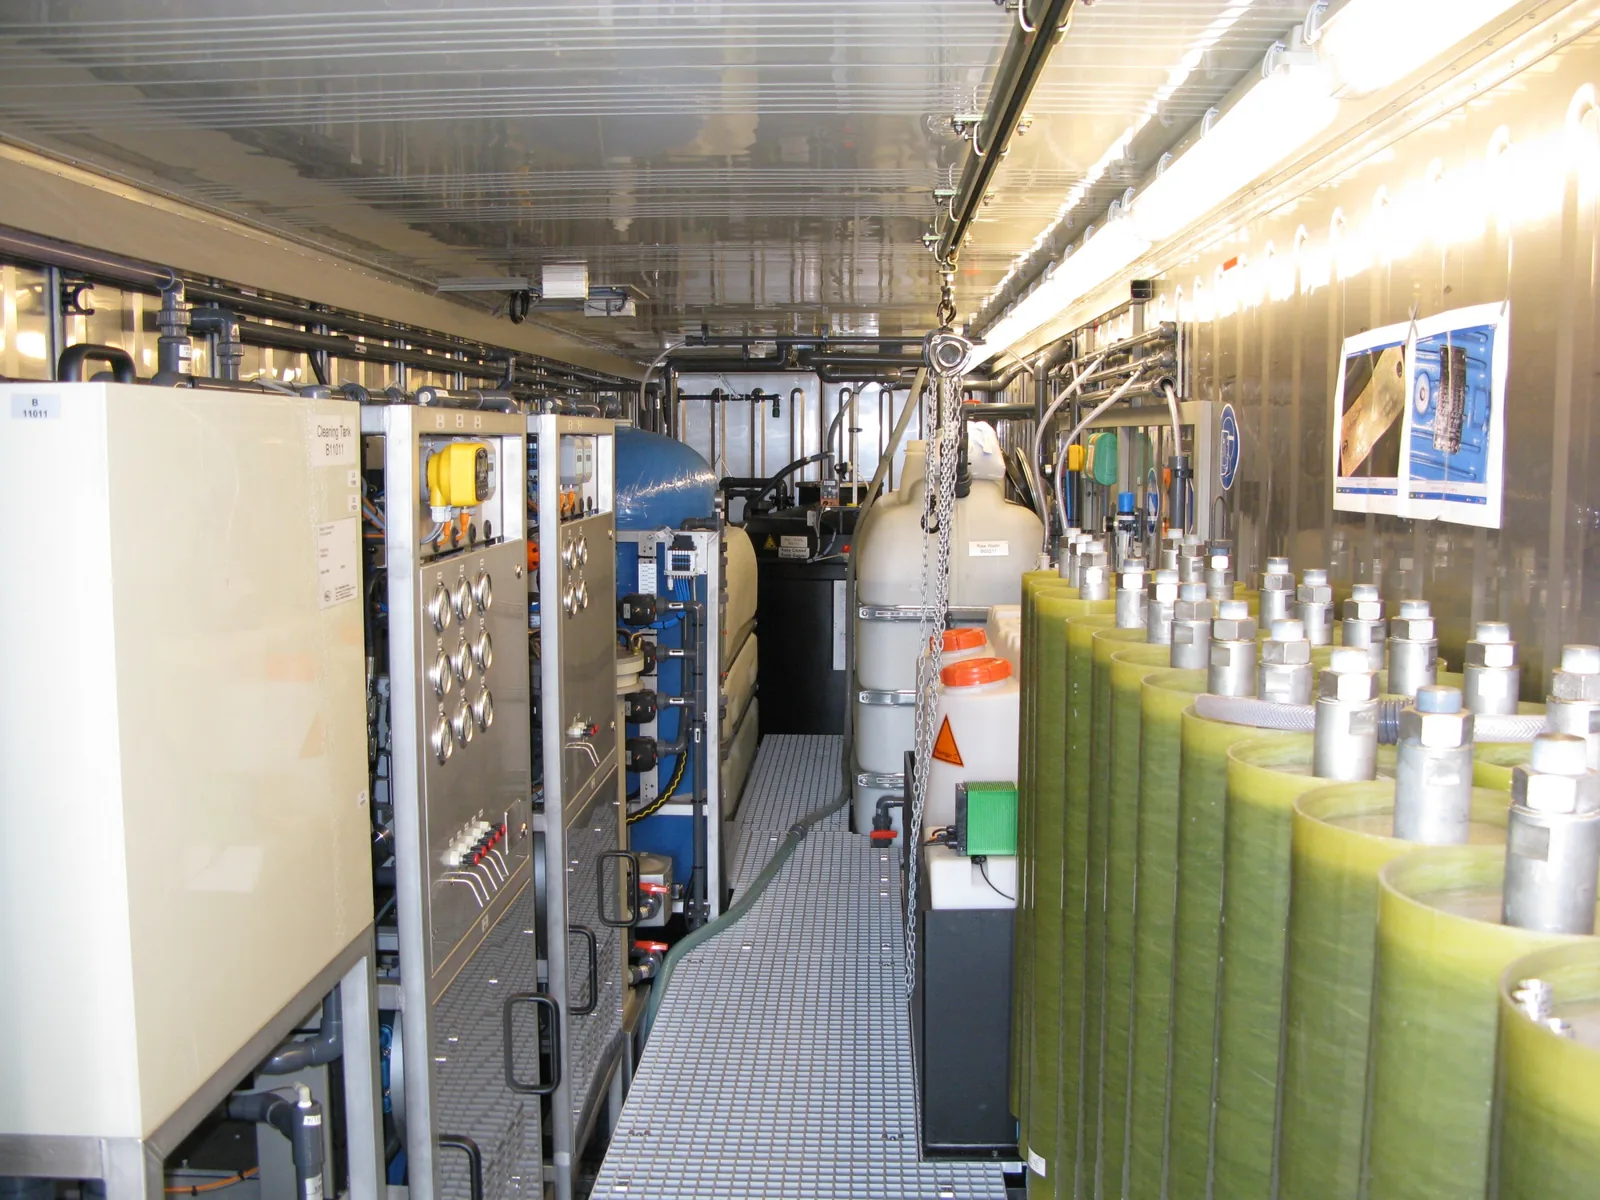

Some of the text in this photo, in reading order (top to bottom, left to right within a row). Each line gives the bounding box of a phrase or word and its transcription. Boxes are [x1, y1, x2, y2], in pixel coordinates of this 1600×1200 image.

[32, 398, 38, 407] B
[23, 409, 48, 418] 11011
[317, 425, 352, 440] Cleaning Tank
[325, 443, 344, 456] B11011
